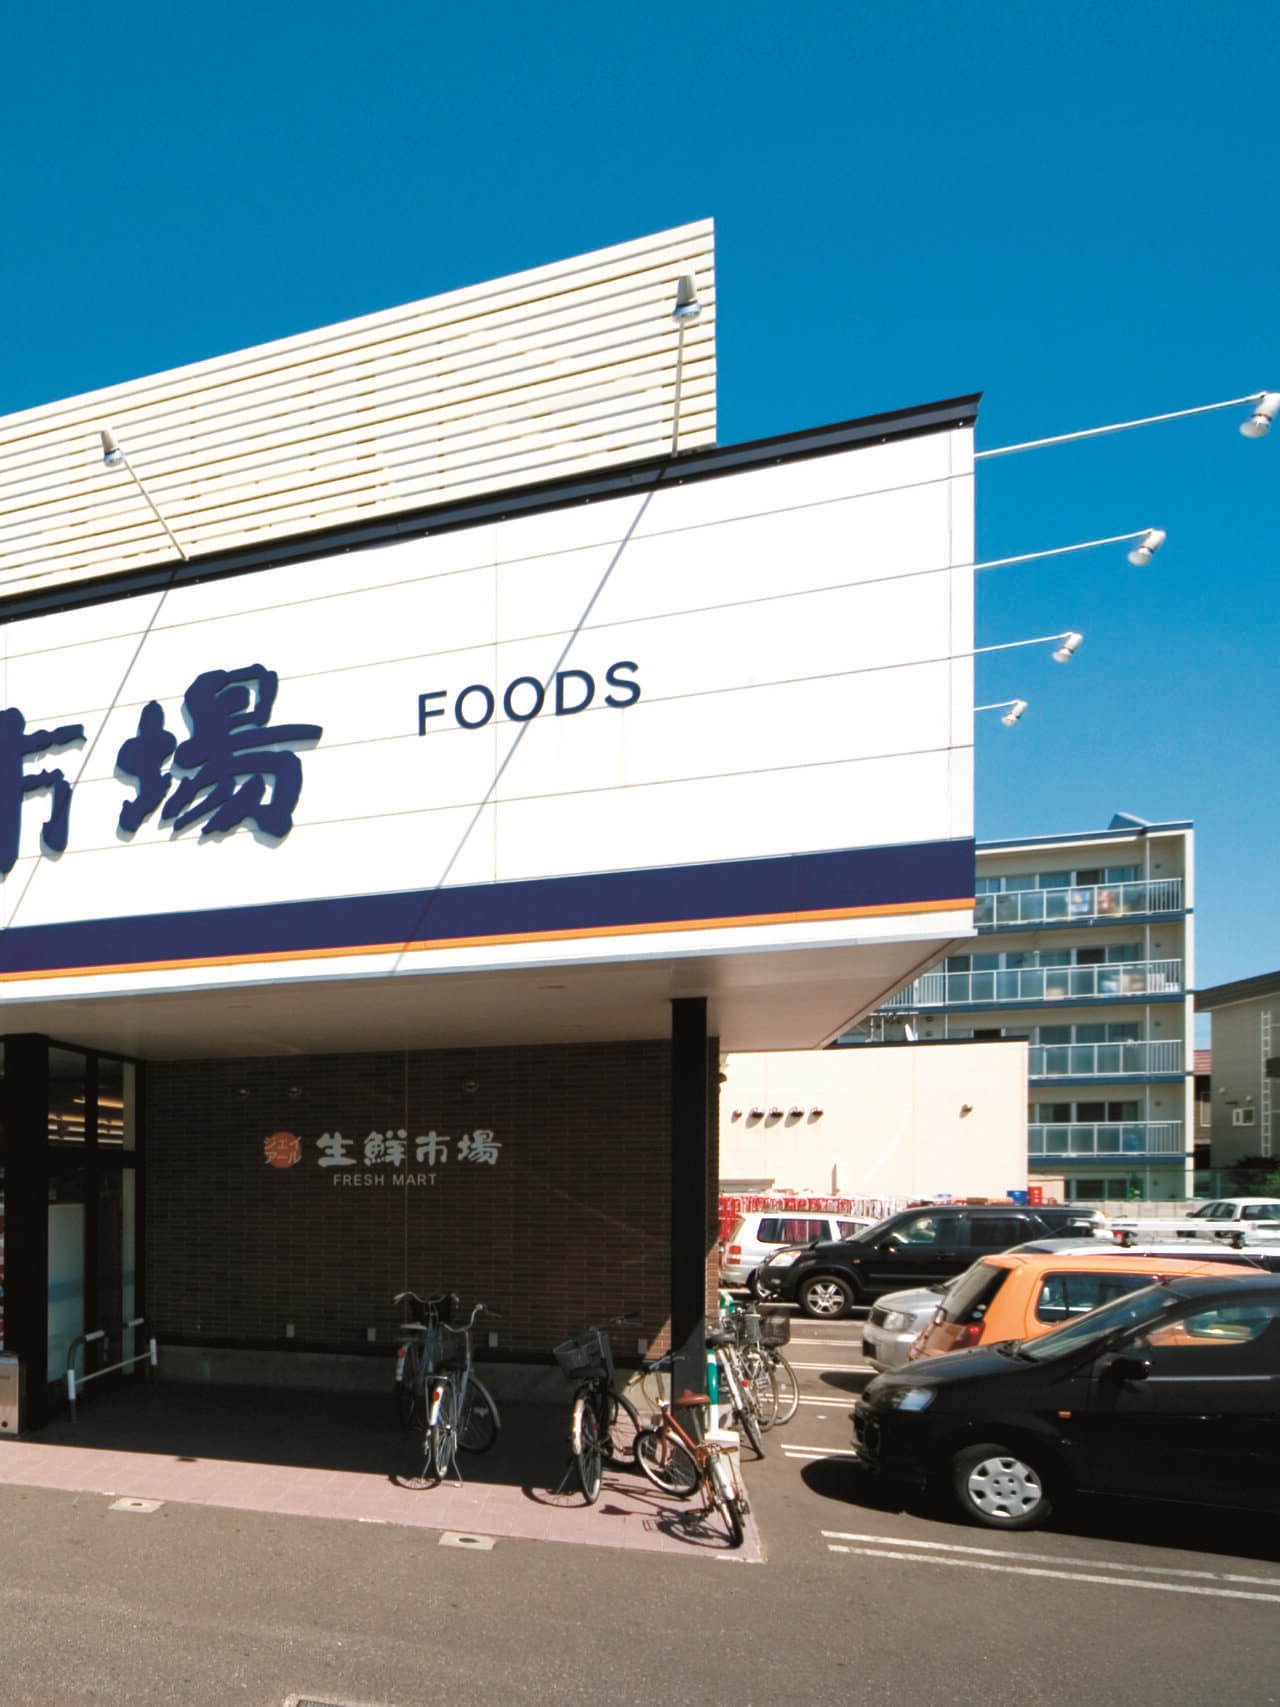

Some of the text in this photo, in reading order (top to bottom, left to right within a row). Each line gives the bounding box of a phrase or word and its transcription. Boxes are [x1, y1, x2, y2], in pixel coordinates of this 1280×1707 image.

[418, 661, 641, 737] FOODS
[264, 1135, 302, 1151] ジェイ
[316, 1129, 502, 1168] 生鮮市場
[265, 1150, 302, 1166] アール
[333, 1173, 438, 1187] FRESH MART
